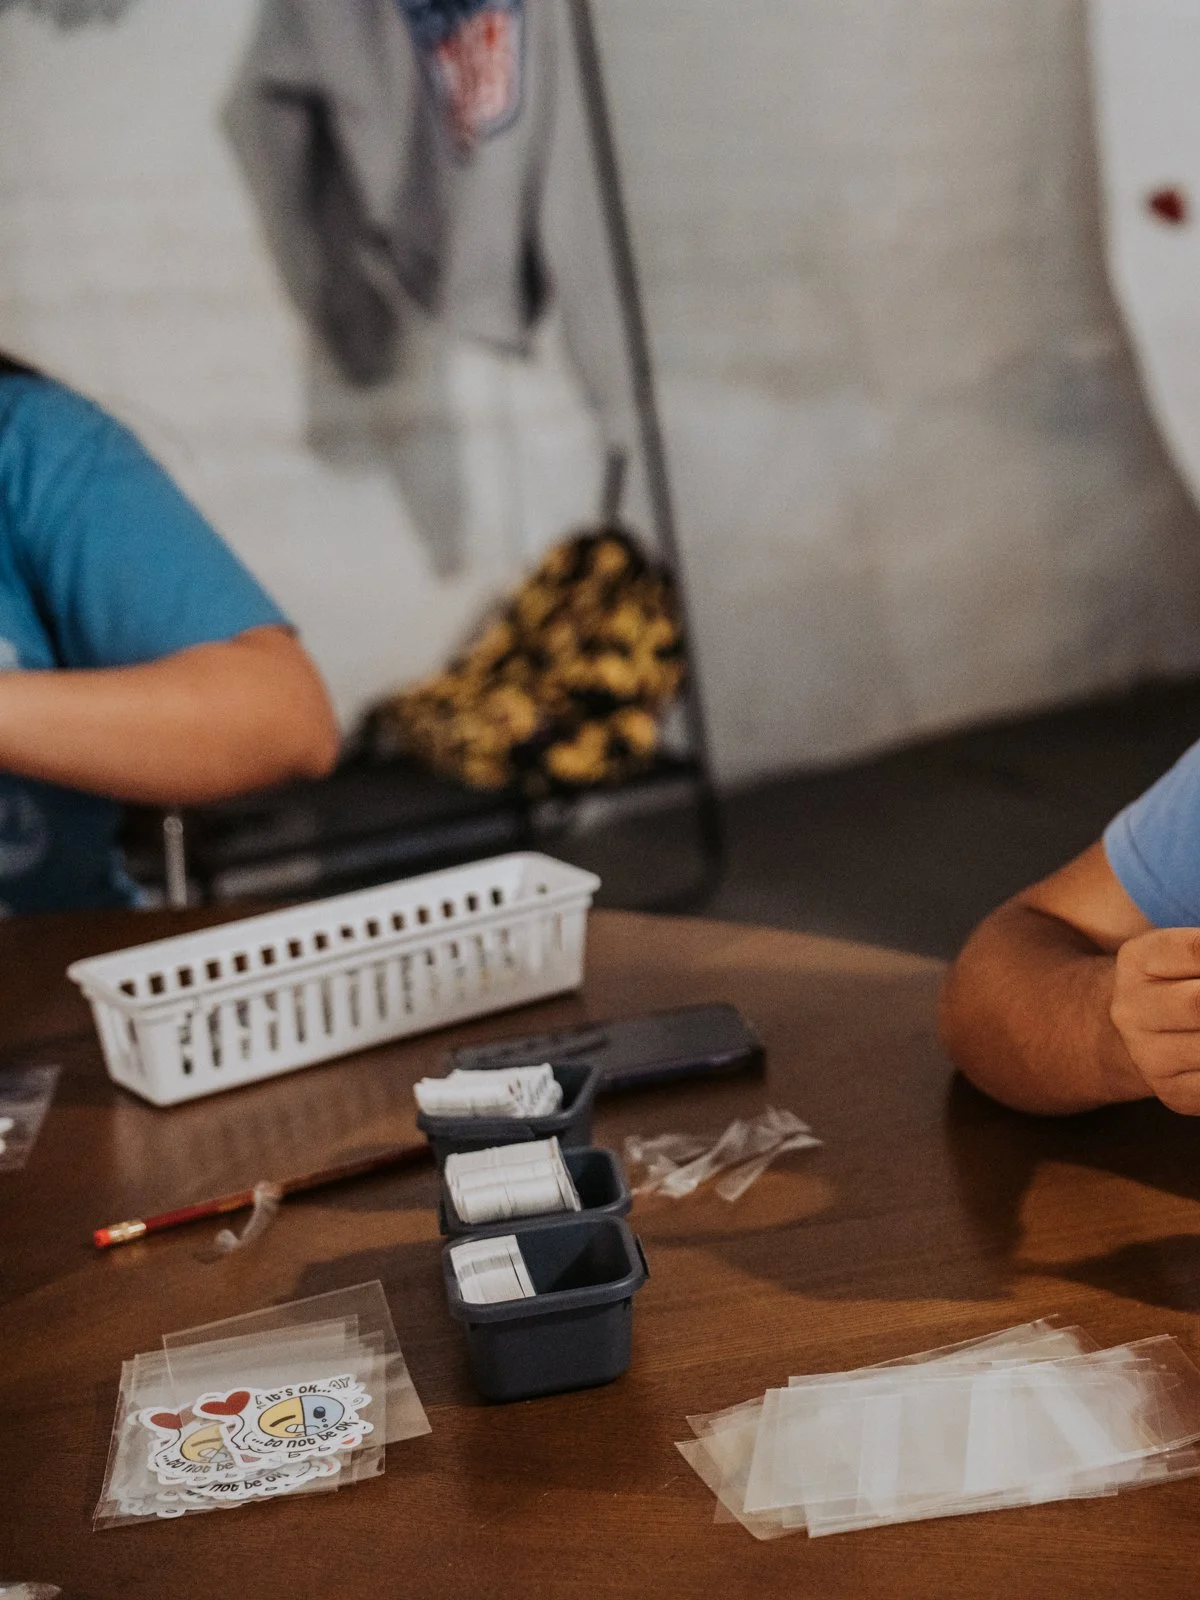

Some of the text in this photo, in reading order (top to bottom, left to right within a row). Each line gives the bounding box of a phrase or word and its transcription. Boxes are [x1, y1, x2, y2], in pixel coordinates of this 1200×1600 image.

[286, 1437, 316, 1449] not
[317, 1431, 338, 1442] be
[181, 1463, 210, 1474] not
[215, 1461, 234, 1472] be
[208, 1483, 240, 1493] not
[244, 1480, 262, 1491] be
